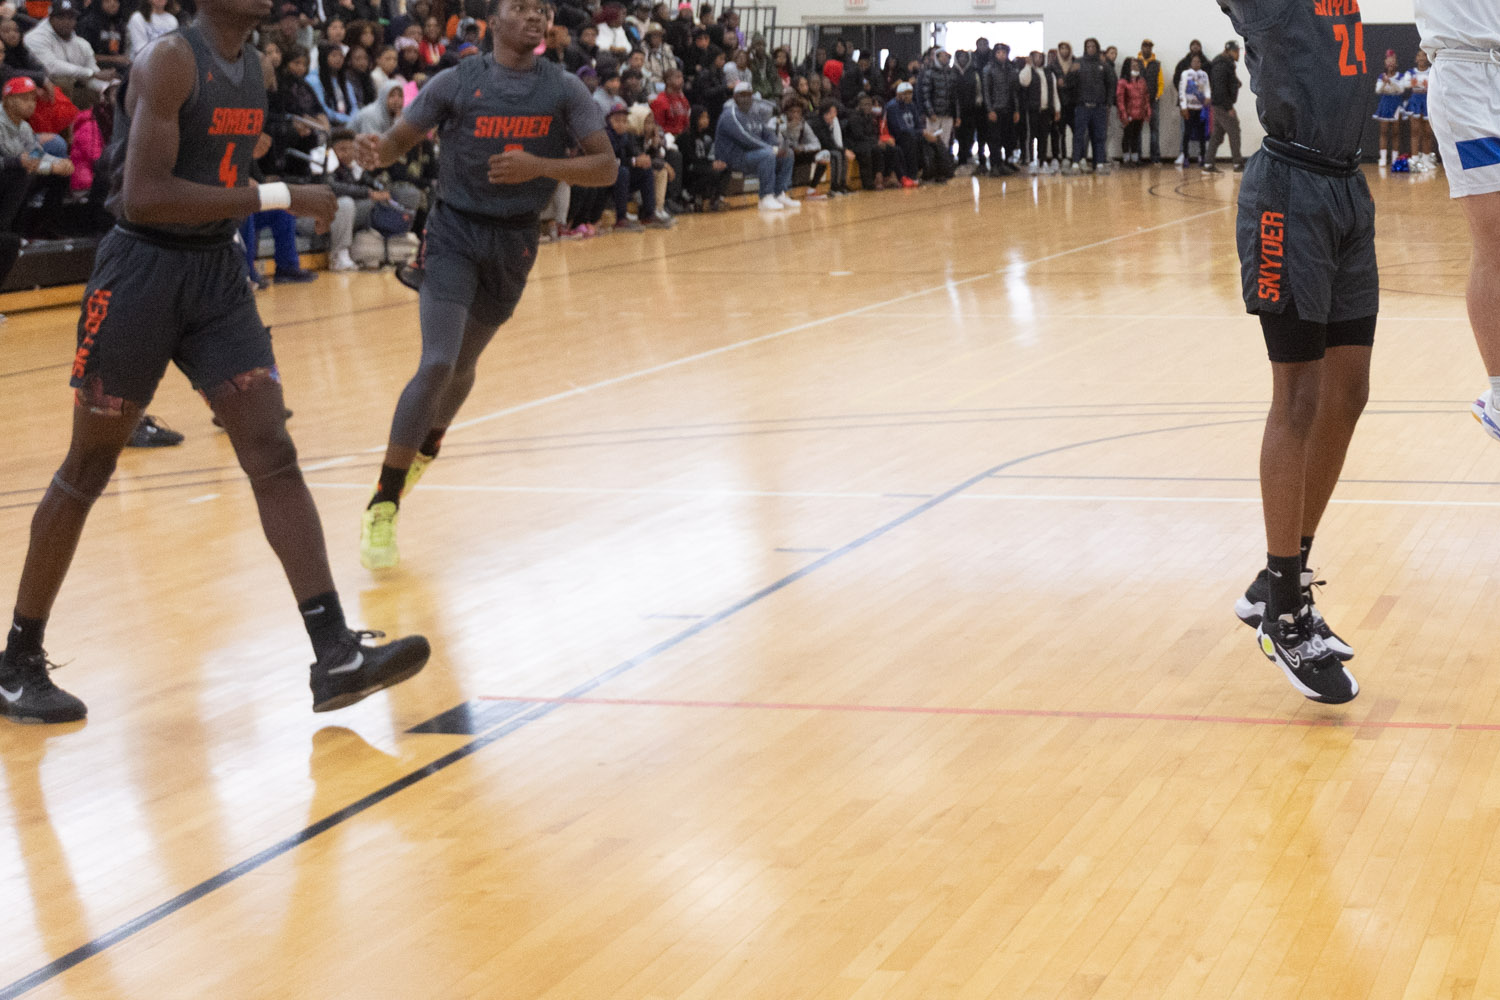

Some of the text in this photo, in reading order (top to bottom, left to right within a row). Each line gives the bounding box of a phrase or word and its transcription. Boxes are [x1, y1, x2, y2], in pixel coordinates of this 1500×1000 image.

[474, 116, 552, 138] SNYDER
[219, 142, 238, 188] 4
[1258, 211, 1284, 302] SNYDER
